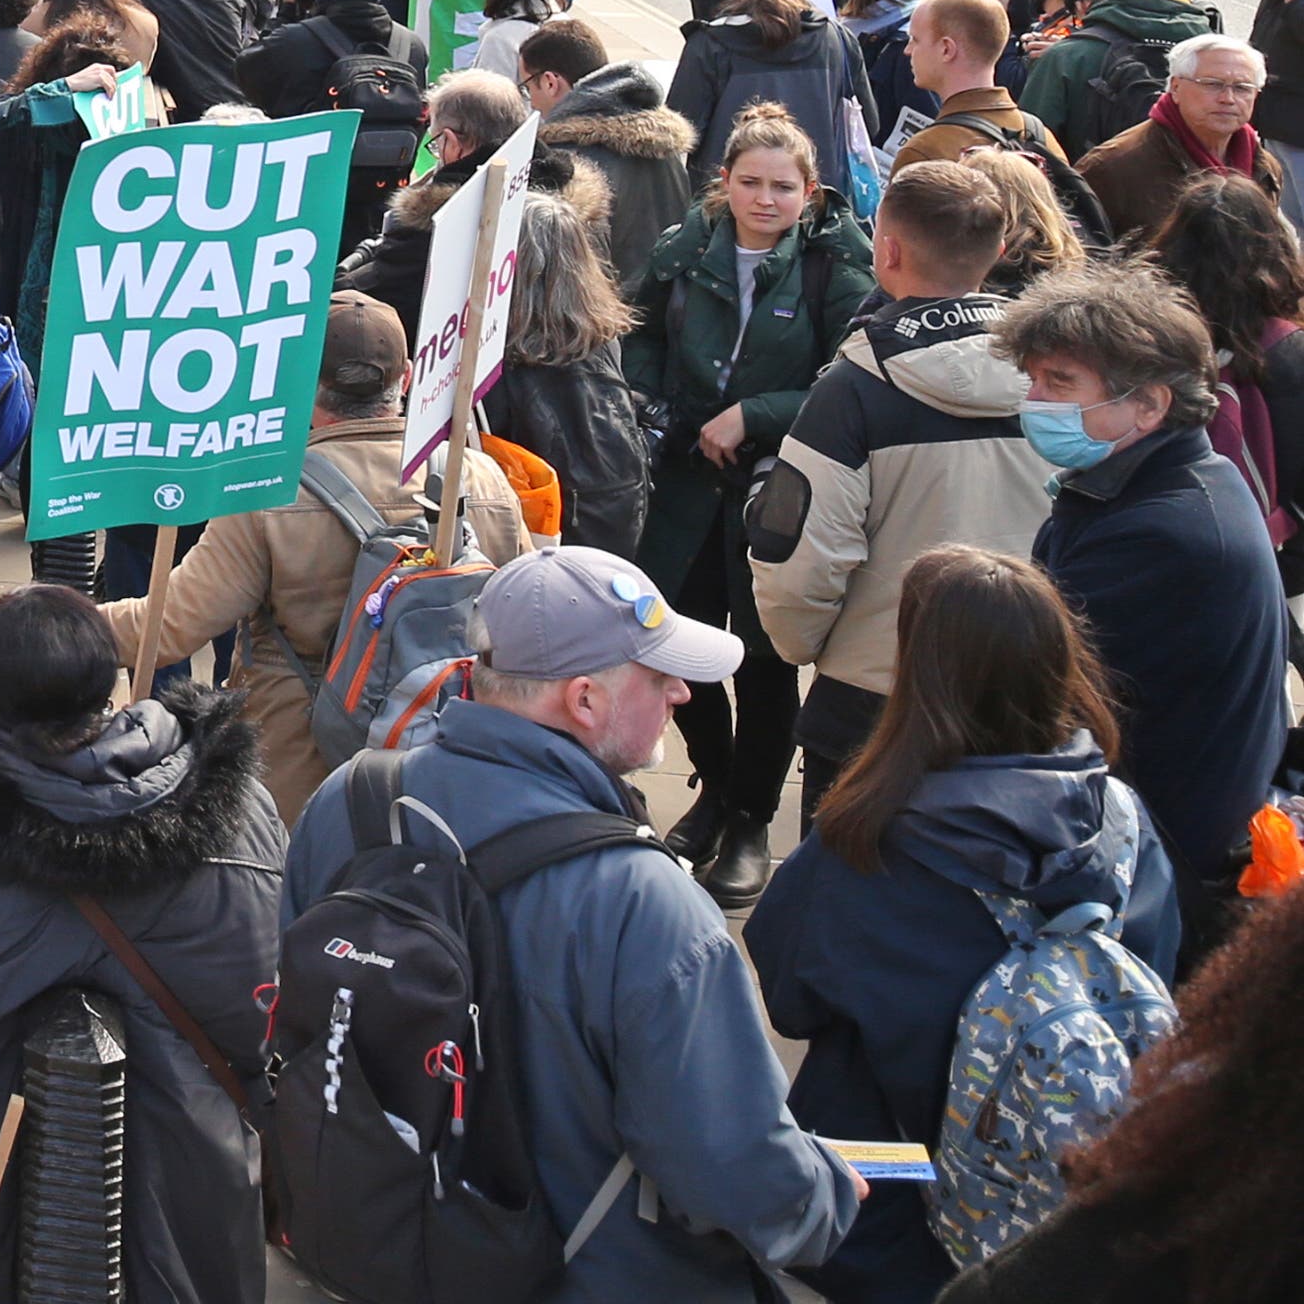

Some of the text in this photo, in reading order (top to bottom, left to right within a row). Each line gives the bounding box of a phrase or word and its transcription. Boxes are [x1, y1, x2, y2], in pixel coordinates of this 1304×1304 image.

[92, 131, 331, 233] CUT
[75, 228, 317, 322] WAR
[63, 313, 306, 416] NOT
[58, 407, 286, 463] WELFARE
[48, 491, 101, 508] Stop the War
[224, 476, 283, 492] stopwar.org.uk
[48, 504, 83, 518] Coalition
[348, 948, 395, 968] berghaus
